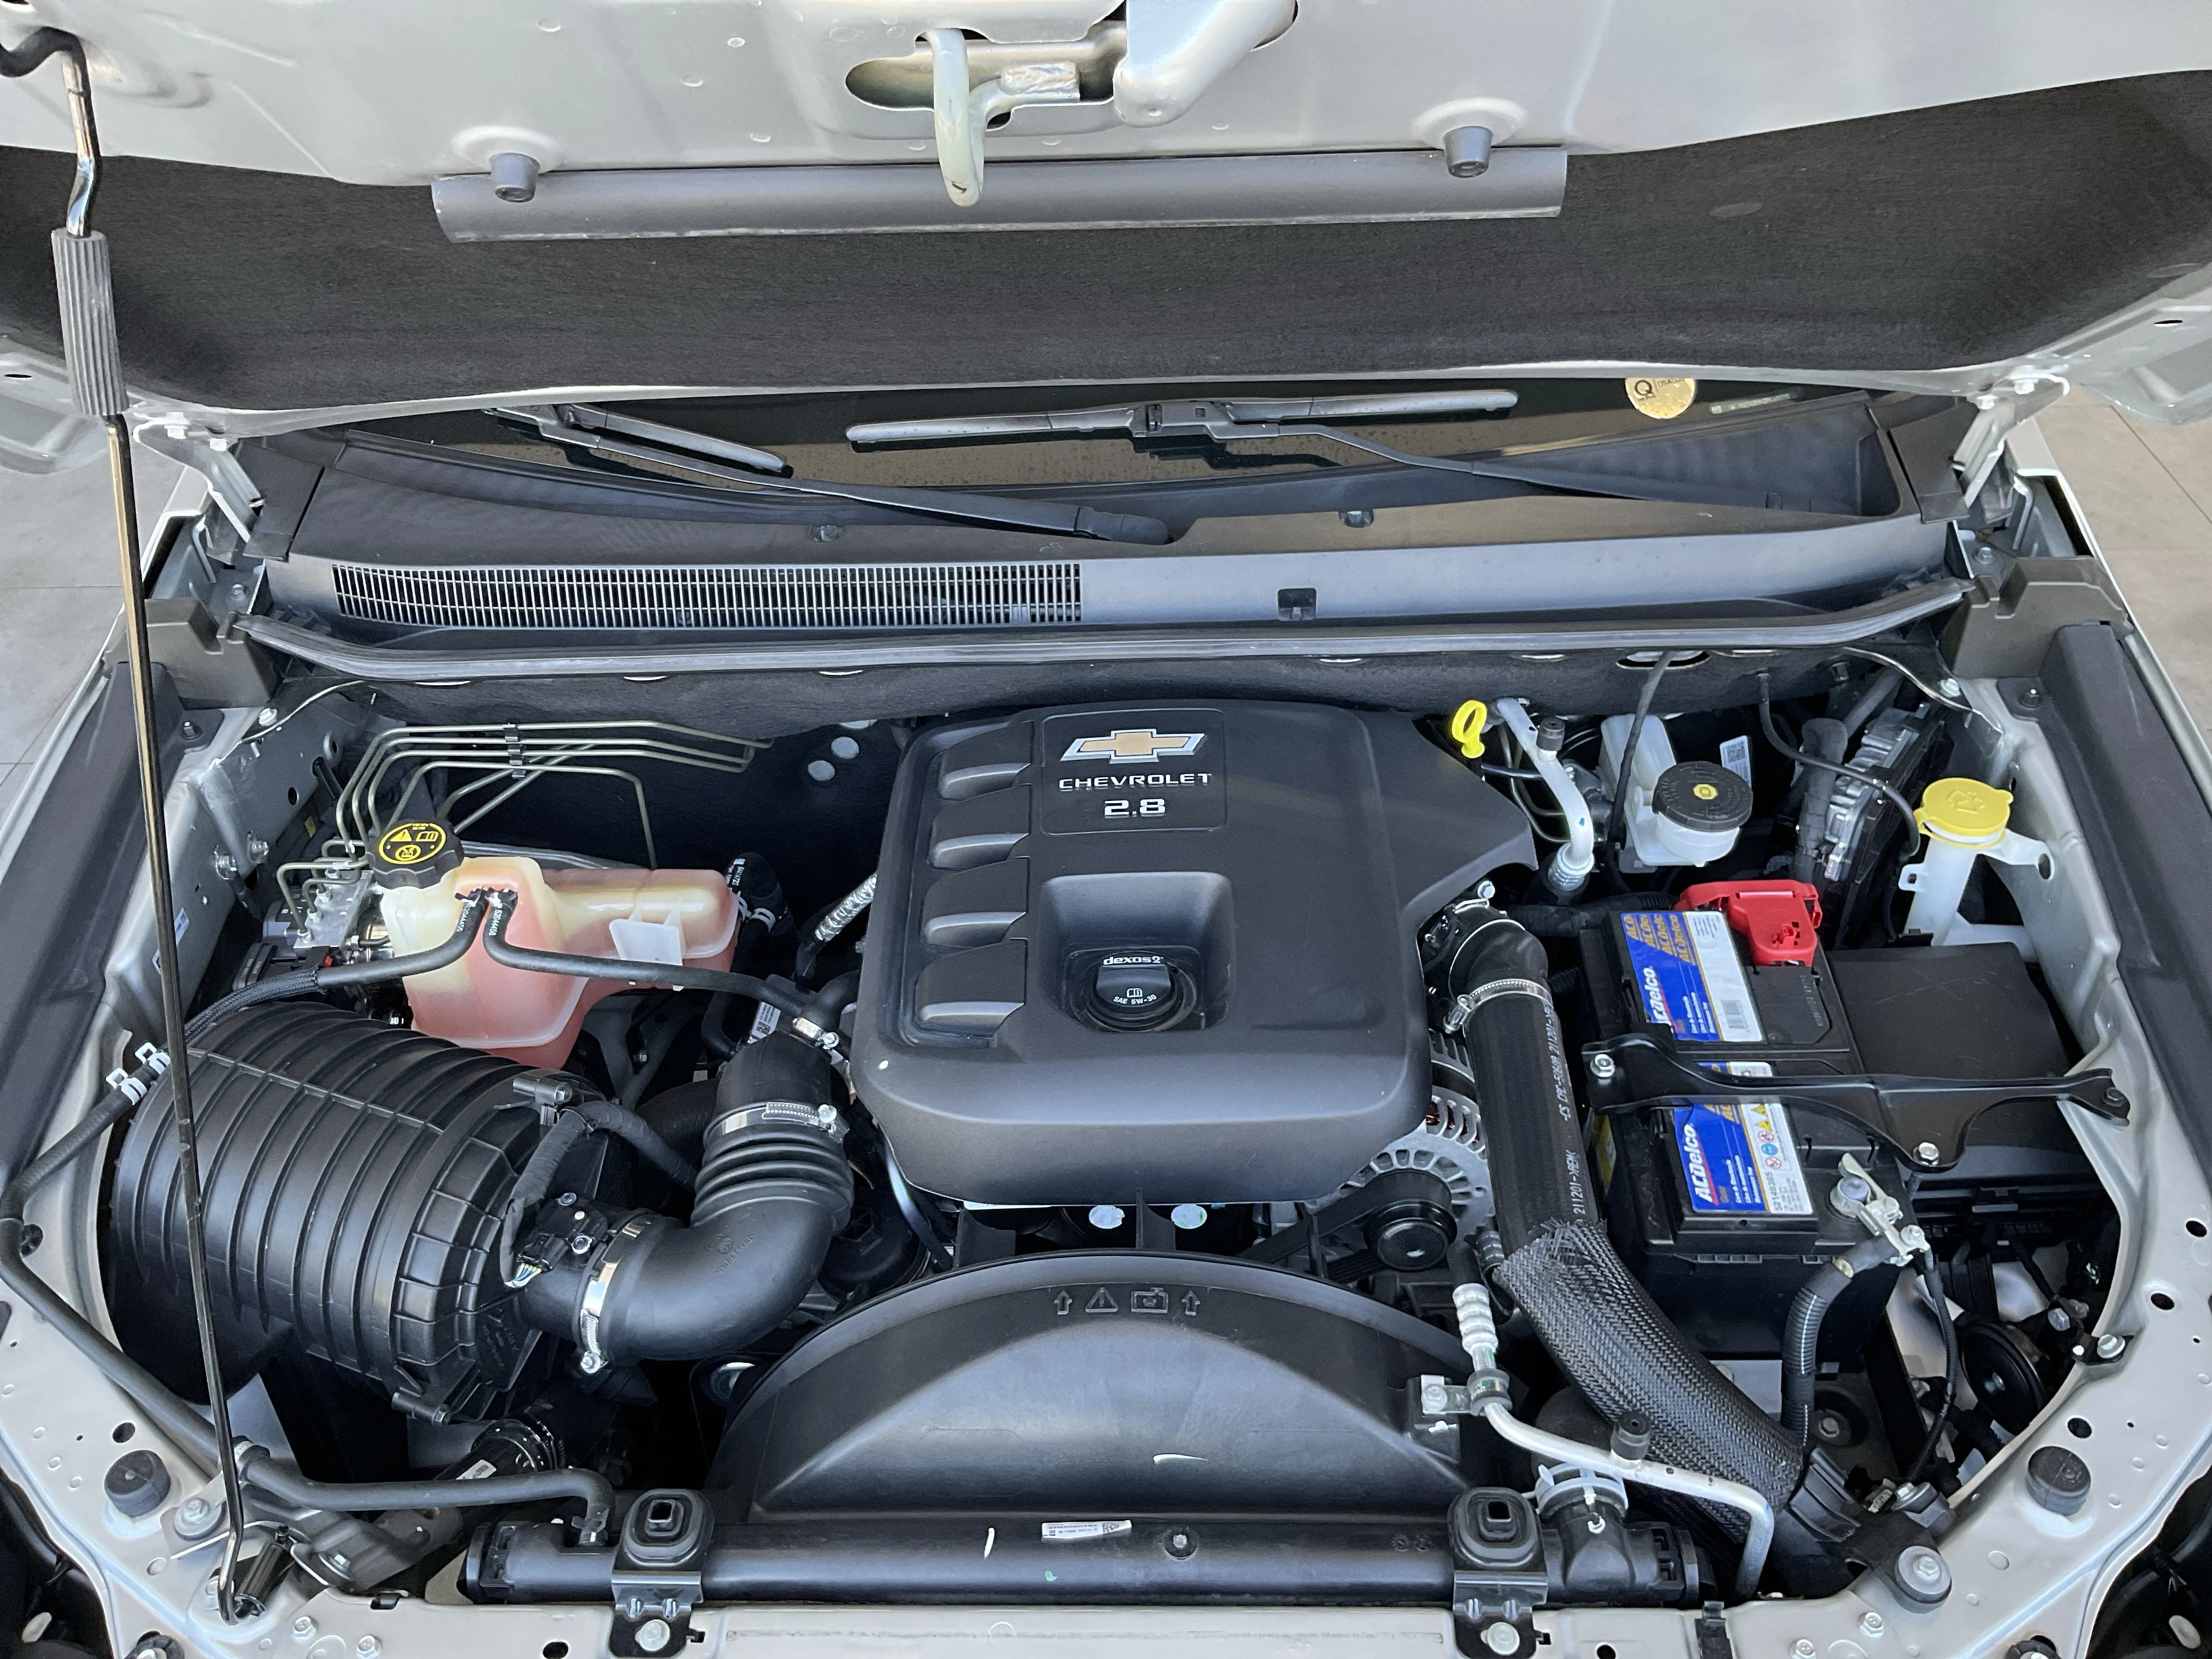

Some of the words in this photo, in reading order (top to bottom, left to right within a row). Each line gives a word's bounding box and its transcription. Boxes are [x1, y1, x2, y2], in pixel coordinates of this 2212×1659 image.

[1634, 379, 1652, 396] Q
[1059, 773, 1212, 790] CHEVROLET
[1104, 799, 1166, 817] 2.8
[1103, 956, 1162, 965] dexos2
[1113, 996, 1128, 1005] SAE
[1131, 994, 1156, 1005] 5W-30
[1684, 1123, 1713, 1203] ACDelco
